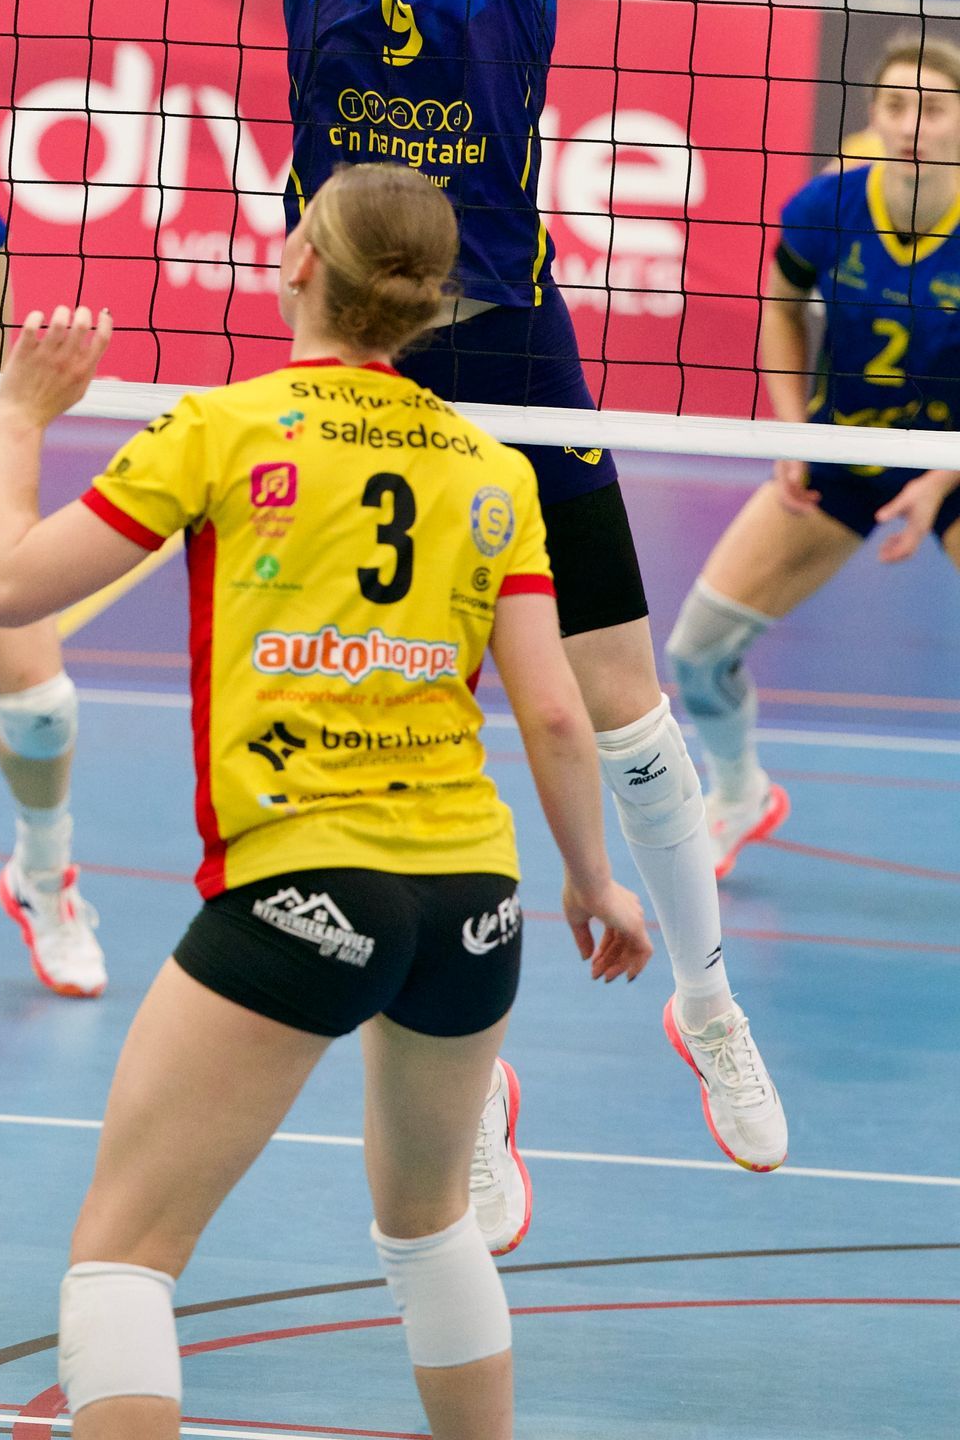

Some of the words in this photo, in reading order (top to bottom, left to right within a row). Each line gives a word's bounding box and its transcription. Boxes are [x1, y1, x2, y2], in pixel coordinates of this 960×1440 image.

[368, 126, 487, 168] hangtafel
[863, 317, 910, 388] 2
[320, 418, 484, 461] salesdock
[356, 471, 417, 605] 3
[257, 629, 455, 678] autohopp
